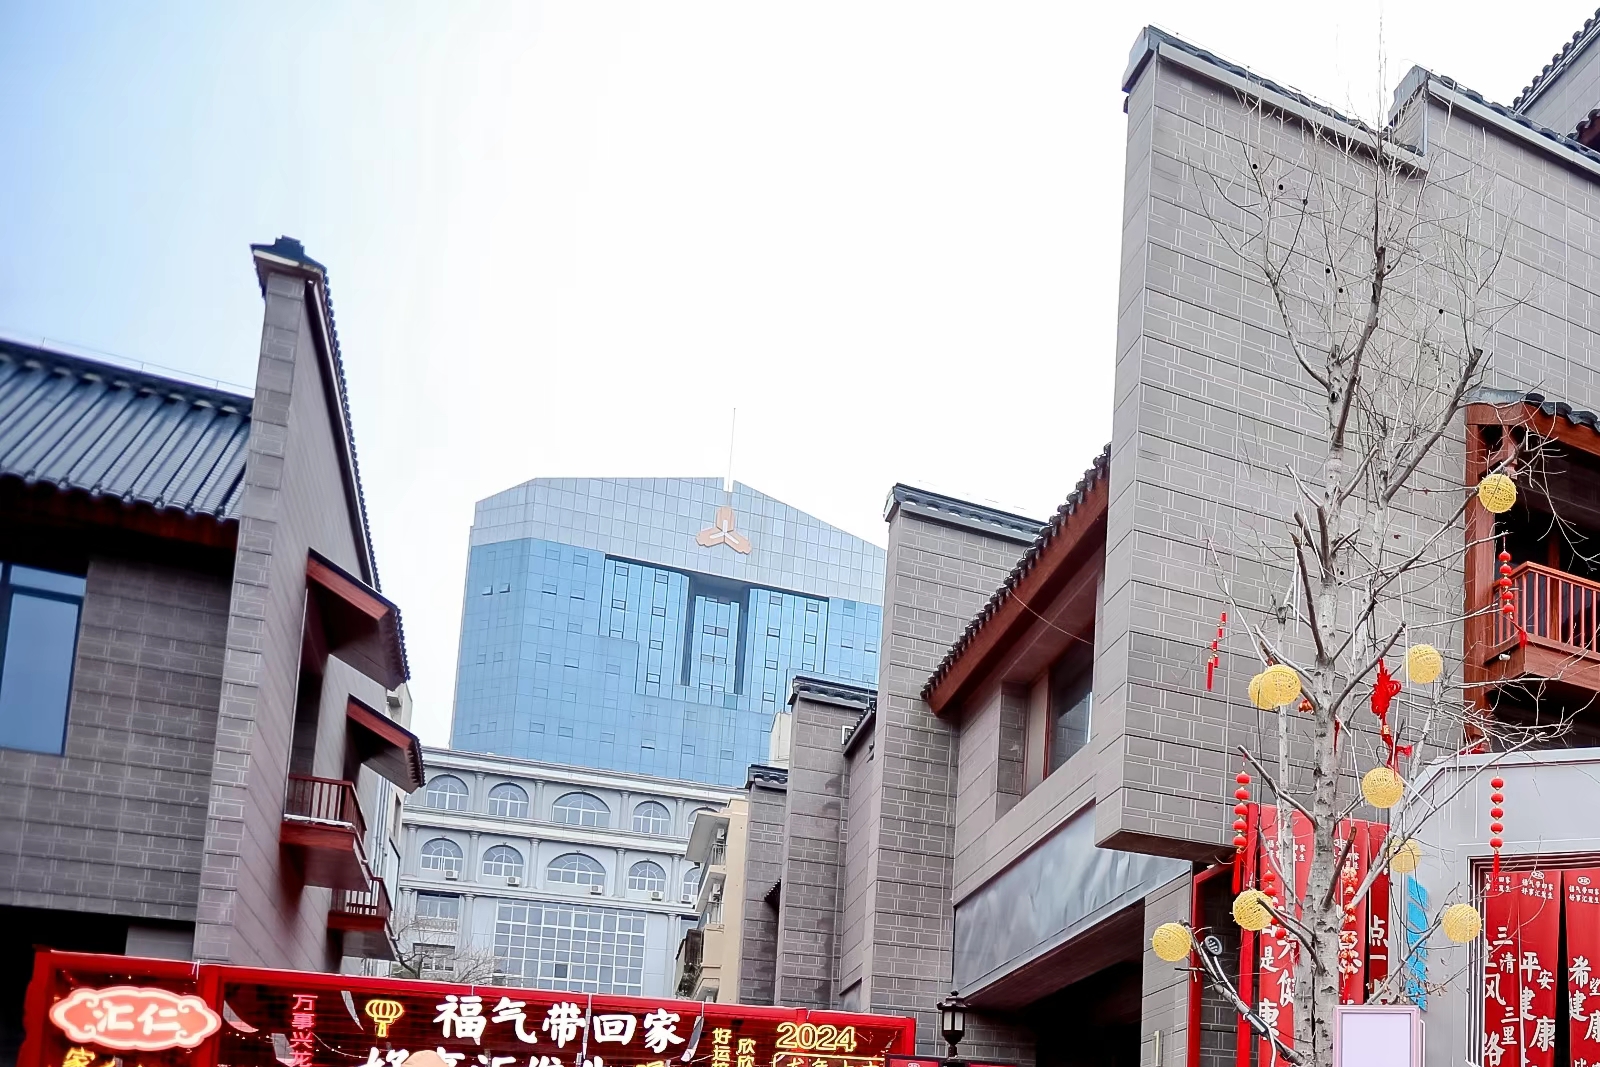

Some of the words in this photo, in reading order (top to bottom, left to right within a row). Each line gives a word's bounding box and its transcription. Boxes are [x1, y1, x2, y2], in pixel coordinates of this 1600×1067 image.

[95, 1003, 184, 1033] 汇仁
[289, 993, 319, 1067] 万事兴龙
[433, 994, 685, 1053] 福气带回家
[775, 1021, 857, 1053] 2024
